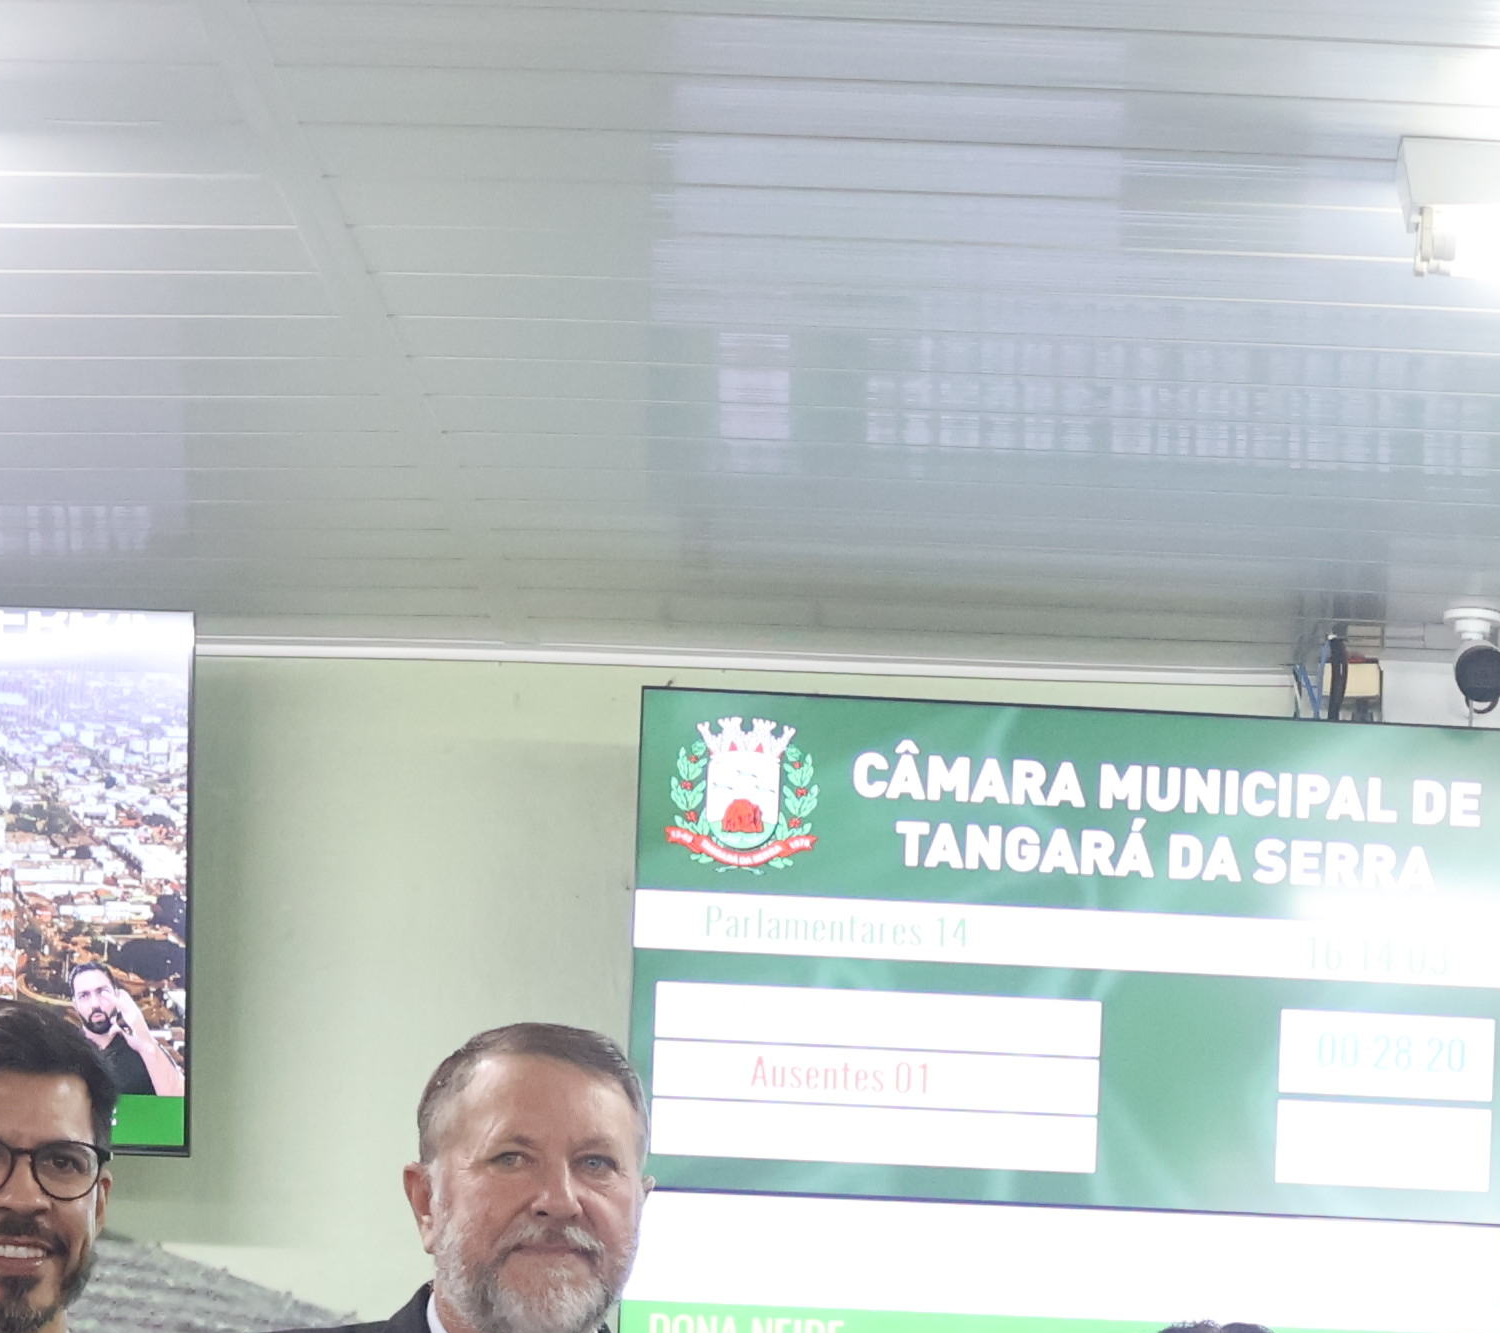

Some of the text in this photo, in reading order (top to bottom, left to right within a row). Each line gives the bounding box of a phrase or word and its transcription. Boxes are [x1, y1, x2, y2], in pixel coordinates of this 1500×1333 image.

[853, 739, 1482, 828] CÂMARA MUNICIPAL DE
[896, 818, 1437, 892] TANGARÁ DA SERRA
[705, 904, 969, 948] Parlamentares 14
[751, 1057, 930, 1095] Ausentes 01
